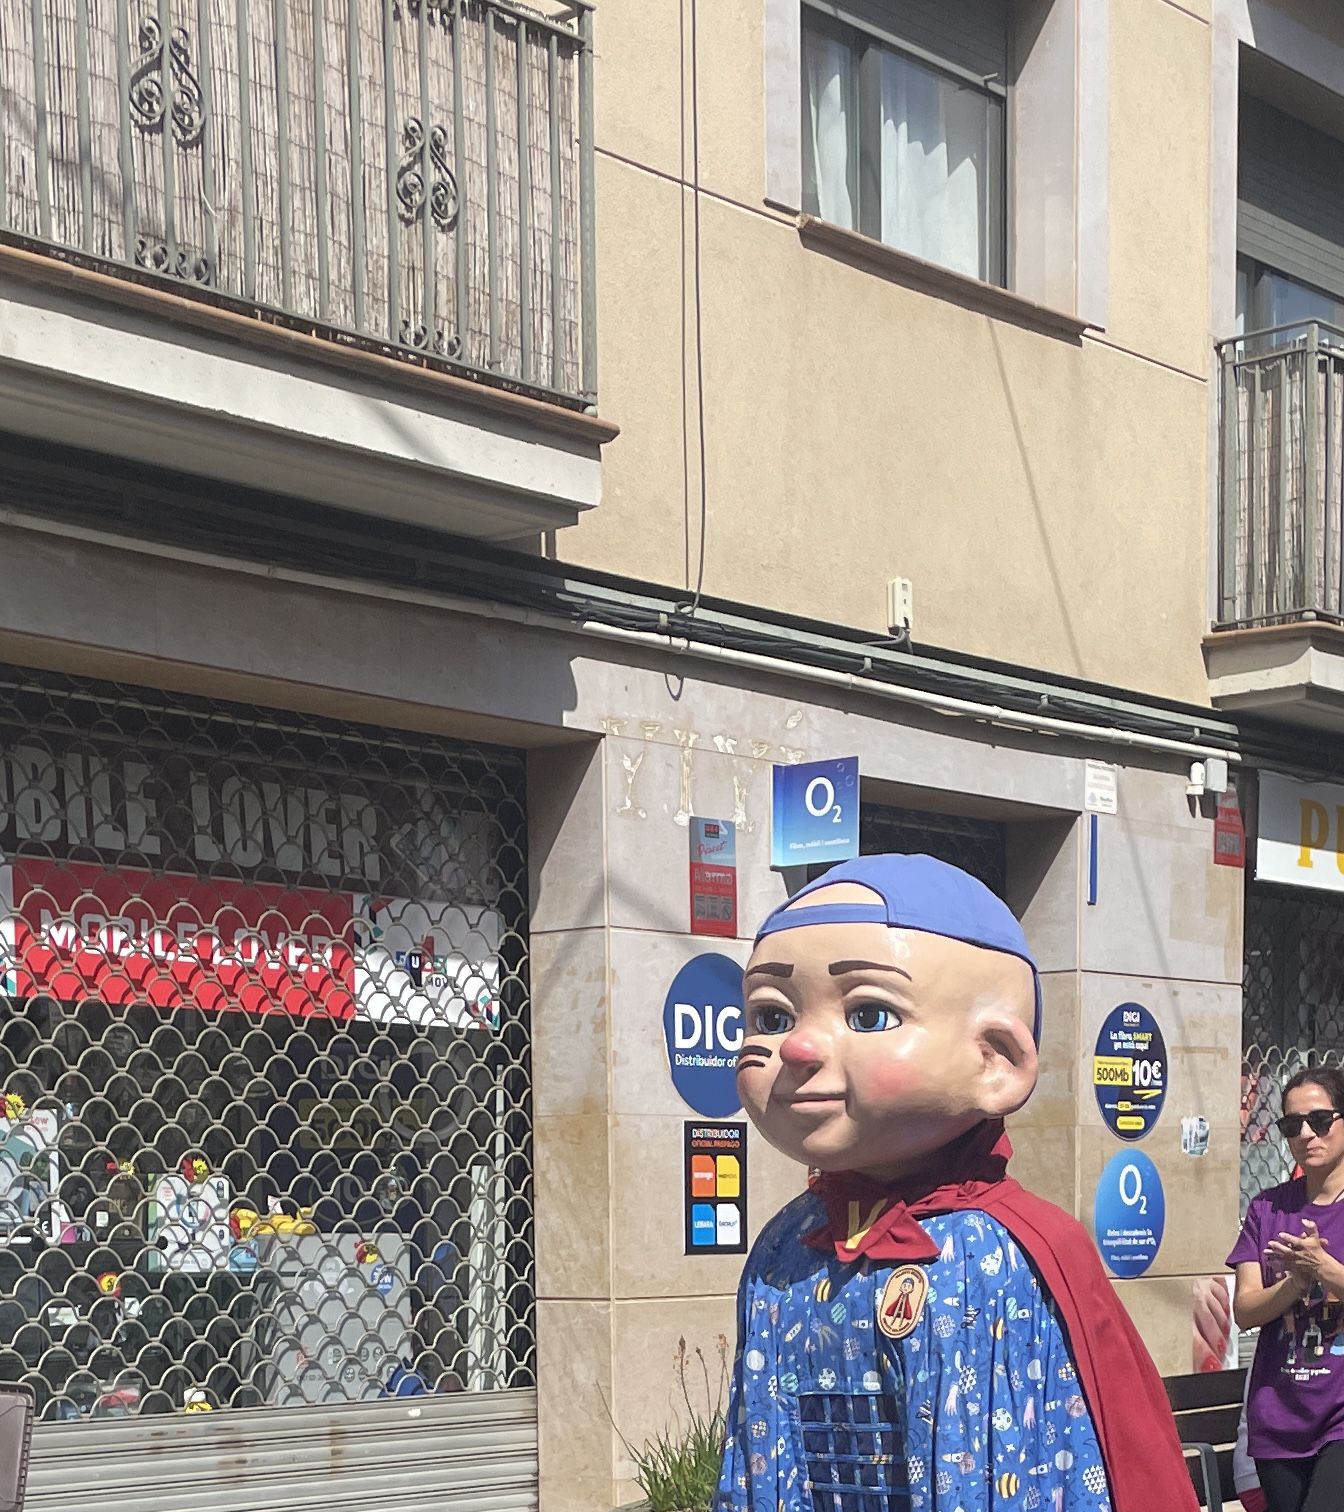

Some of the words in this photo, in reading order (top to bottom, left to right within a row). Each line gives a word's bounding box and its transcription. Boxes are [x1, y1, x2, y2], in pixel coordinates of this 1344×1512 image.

[805, 776, 842, 823] O2
[189, 769, 381, 881] LOVER
[40, 909, 200, 963] MOBILE
[212, 925, 334, 973] LOVER
[675, 1053, 726, 1067] Distribuidor
[1096, 1066, 1130, 1083] 500Mb
[692, 1128, 740, 1139] DISTRIBUIDOR
[1119, 1164, 1147, 1215] O2
